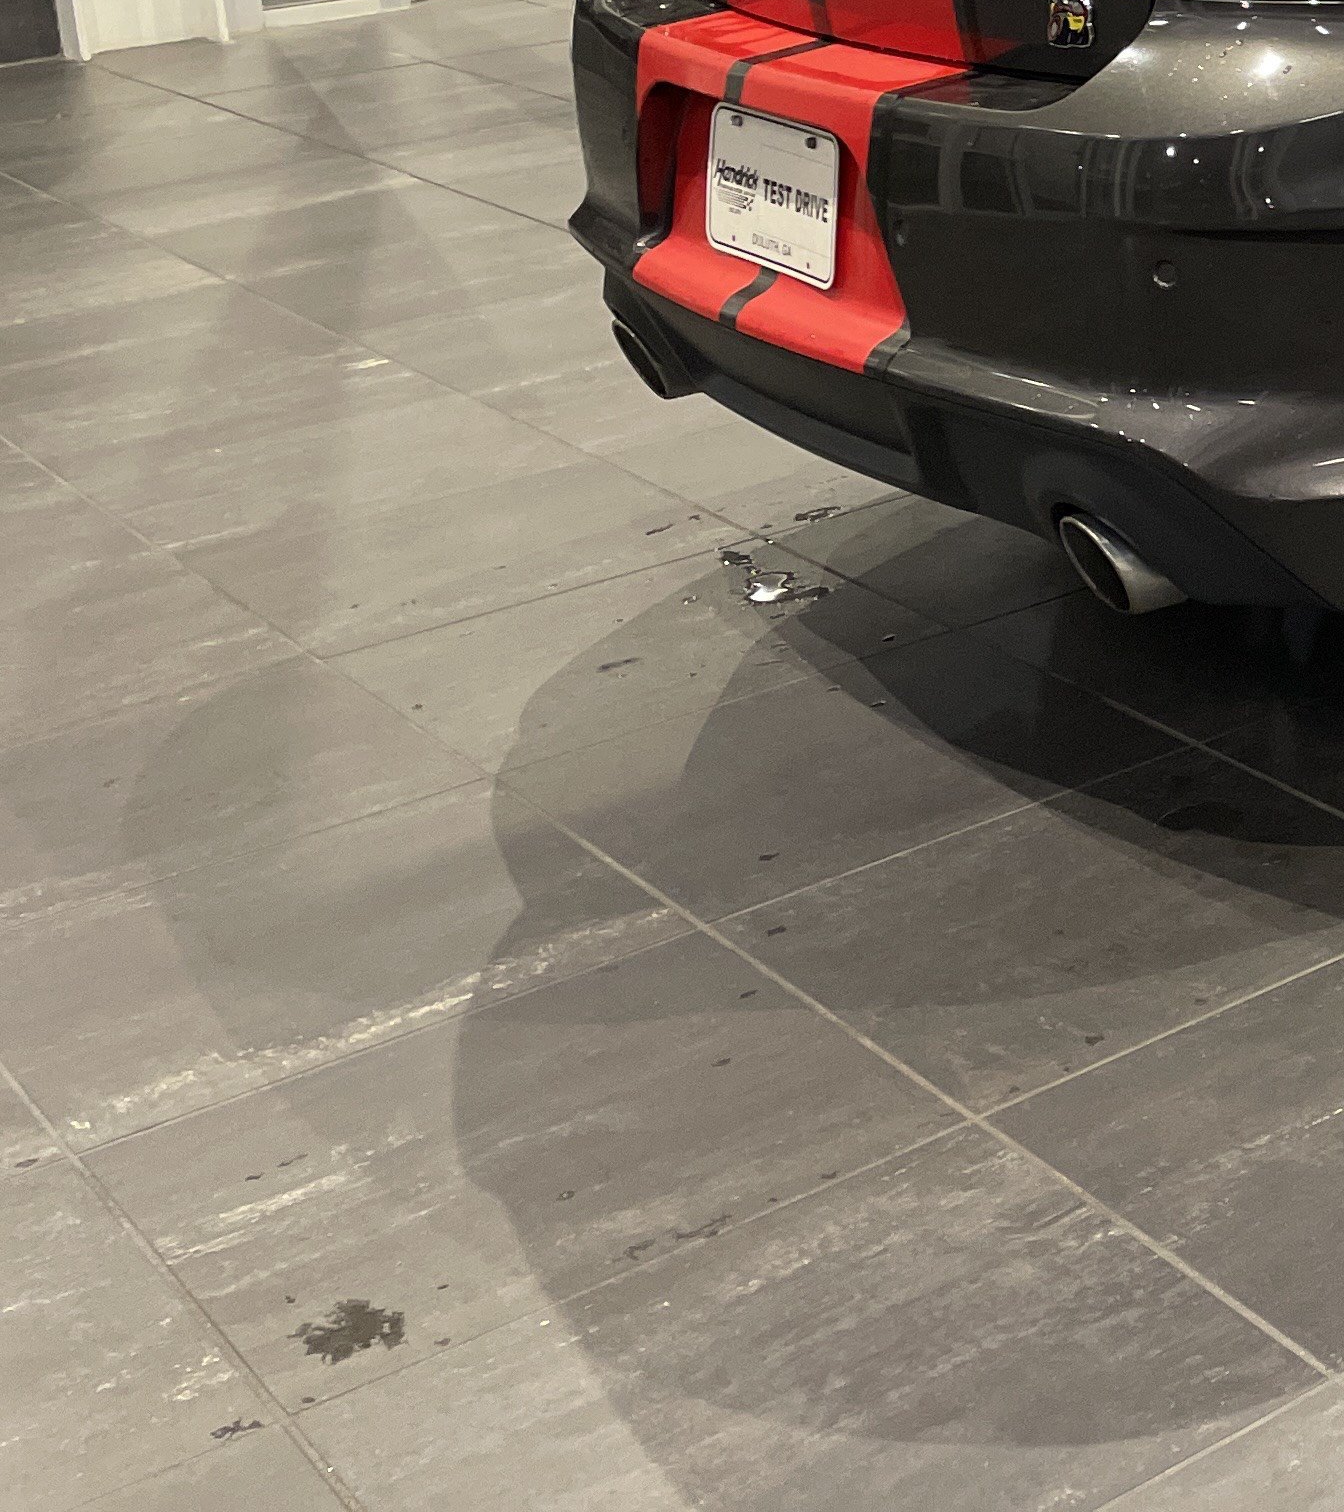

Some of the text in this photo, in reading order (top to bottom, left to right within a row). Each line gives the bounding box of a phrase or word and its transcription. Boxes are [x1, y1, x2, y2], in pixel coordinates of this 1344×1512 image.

[713, 158, 759, 190] Hendrick
[763, 178, 792, 209] TEST
[796, 189, 829, 223] DRIVE
